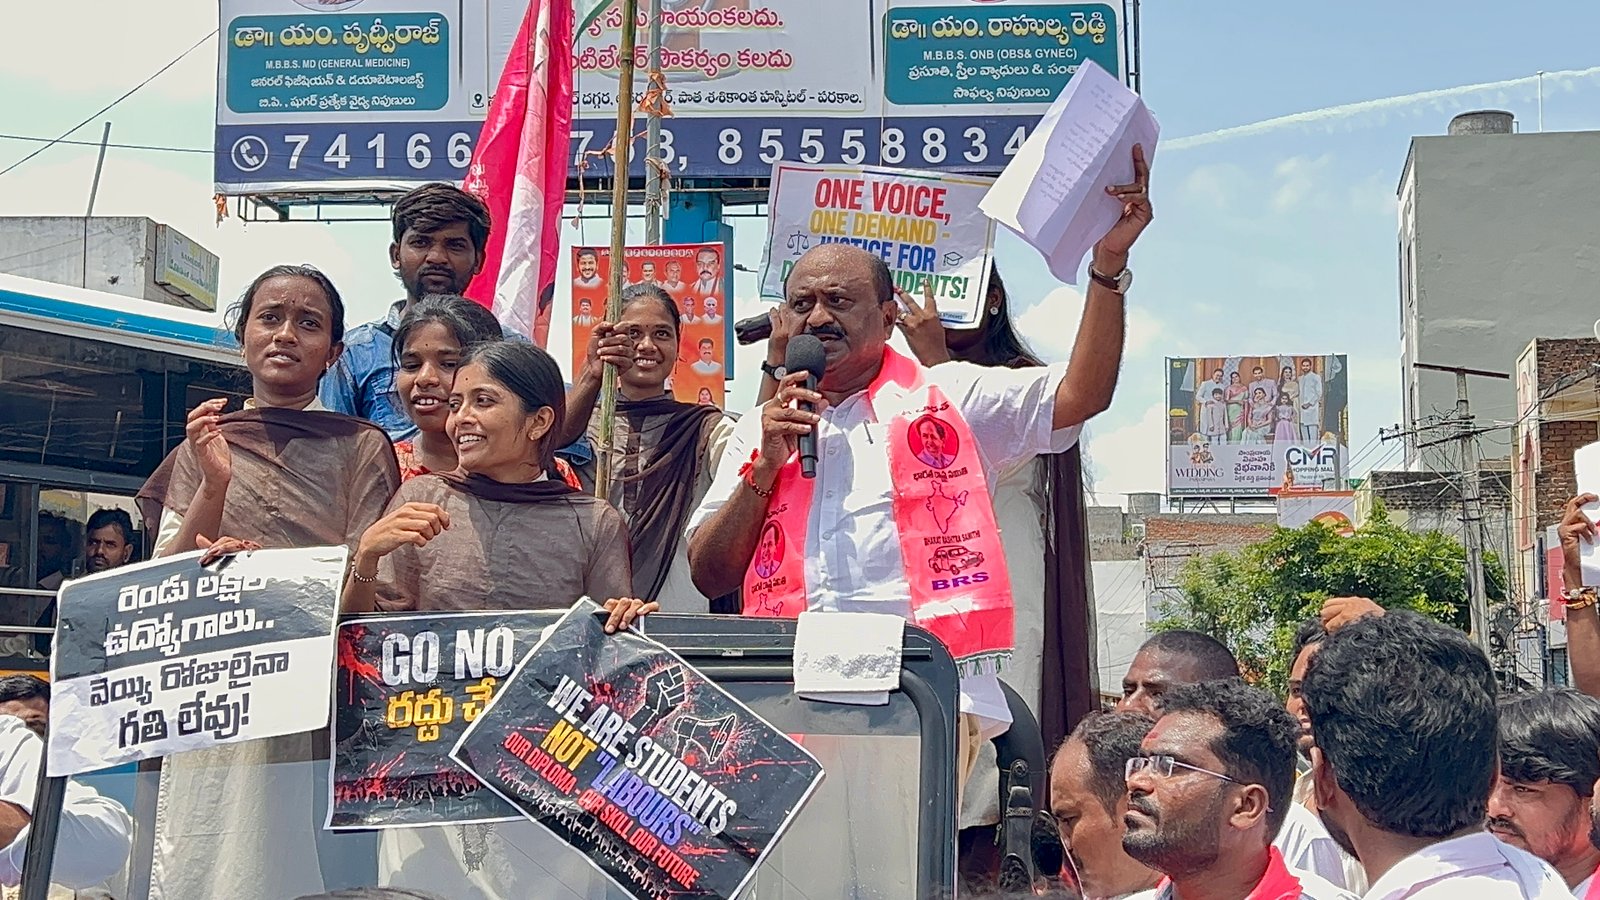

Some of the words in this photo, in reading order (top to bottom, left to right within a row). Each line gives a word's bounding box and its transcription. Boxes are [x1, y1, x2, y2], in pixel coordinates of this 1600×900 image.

[1070, 12, 1107, 44] రెడ్డి
[266, 59, 300, 70] M.B.B.S.
[302, 58, 317, 69] MD
[318, 58, 363, 70] (GENERAL
[365, 58, 411, 69] MEDICINE)
[737, 48, 793, 69] కలదు
[923, 50, 967, 61] M.B.B.S.
[970, 49, 995, 60] ONB
[1035, 48, 1078, 60] GYNEC)
[1031, 64, 1044, 75] &
[1048, 63, 1079, 75] సంతా
[335, 75, 347, 86] &
[815, 178, 865, 211] ONE
[871, 181, 952, 226] VOICE,
[809, 210, 848, 236] ONE
[852, 211, 938, 245] DEMAND
[896, 244, 938, 272] FOR
[1286, 445, 1337, 466] CMR
[1175, 468, 1225, 478] WEDDING
[117, 572, 190, 614] రెండు
[931, 571, 990, 591] BRS
[382, 631, 440, 687] GO
[90, 675, 152, 707] వెయ్యి
[160, 650, 291, 692] రోజులైనా
[118, 708, 169, 750] గతి
[177, 691, 251, 741] లేవు!
[385, 687, 455, 743] రద్దు
[547, 674, 595, 725] WE
[580, 703, 638, 759] ARE
[624, 735, 738, 837] STUDENTS
[540, 718, 598, 772] NOT
[590, 750, 704, 847] "LABOURS"
[504, 731, 532, 760] OUR
[525, 747, 579, 797] DIPLOMA
[577, 788, 606, 815] OUR
[600, 803, 635, 840] SKILL
[628, 828, 658, 859] OUR
[650, 844, 701, 890] FUTURE
